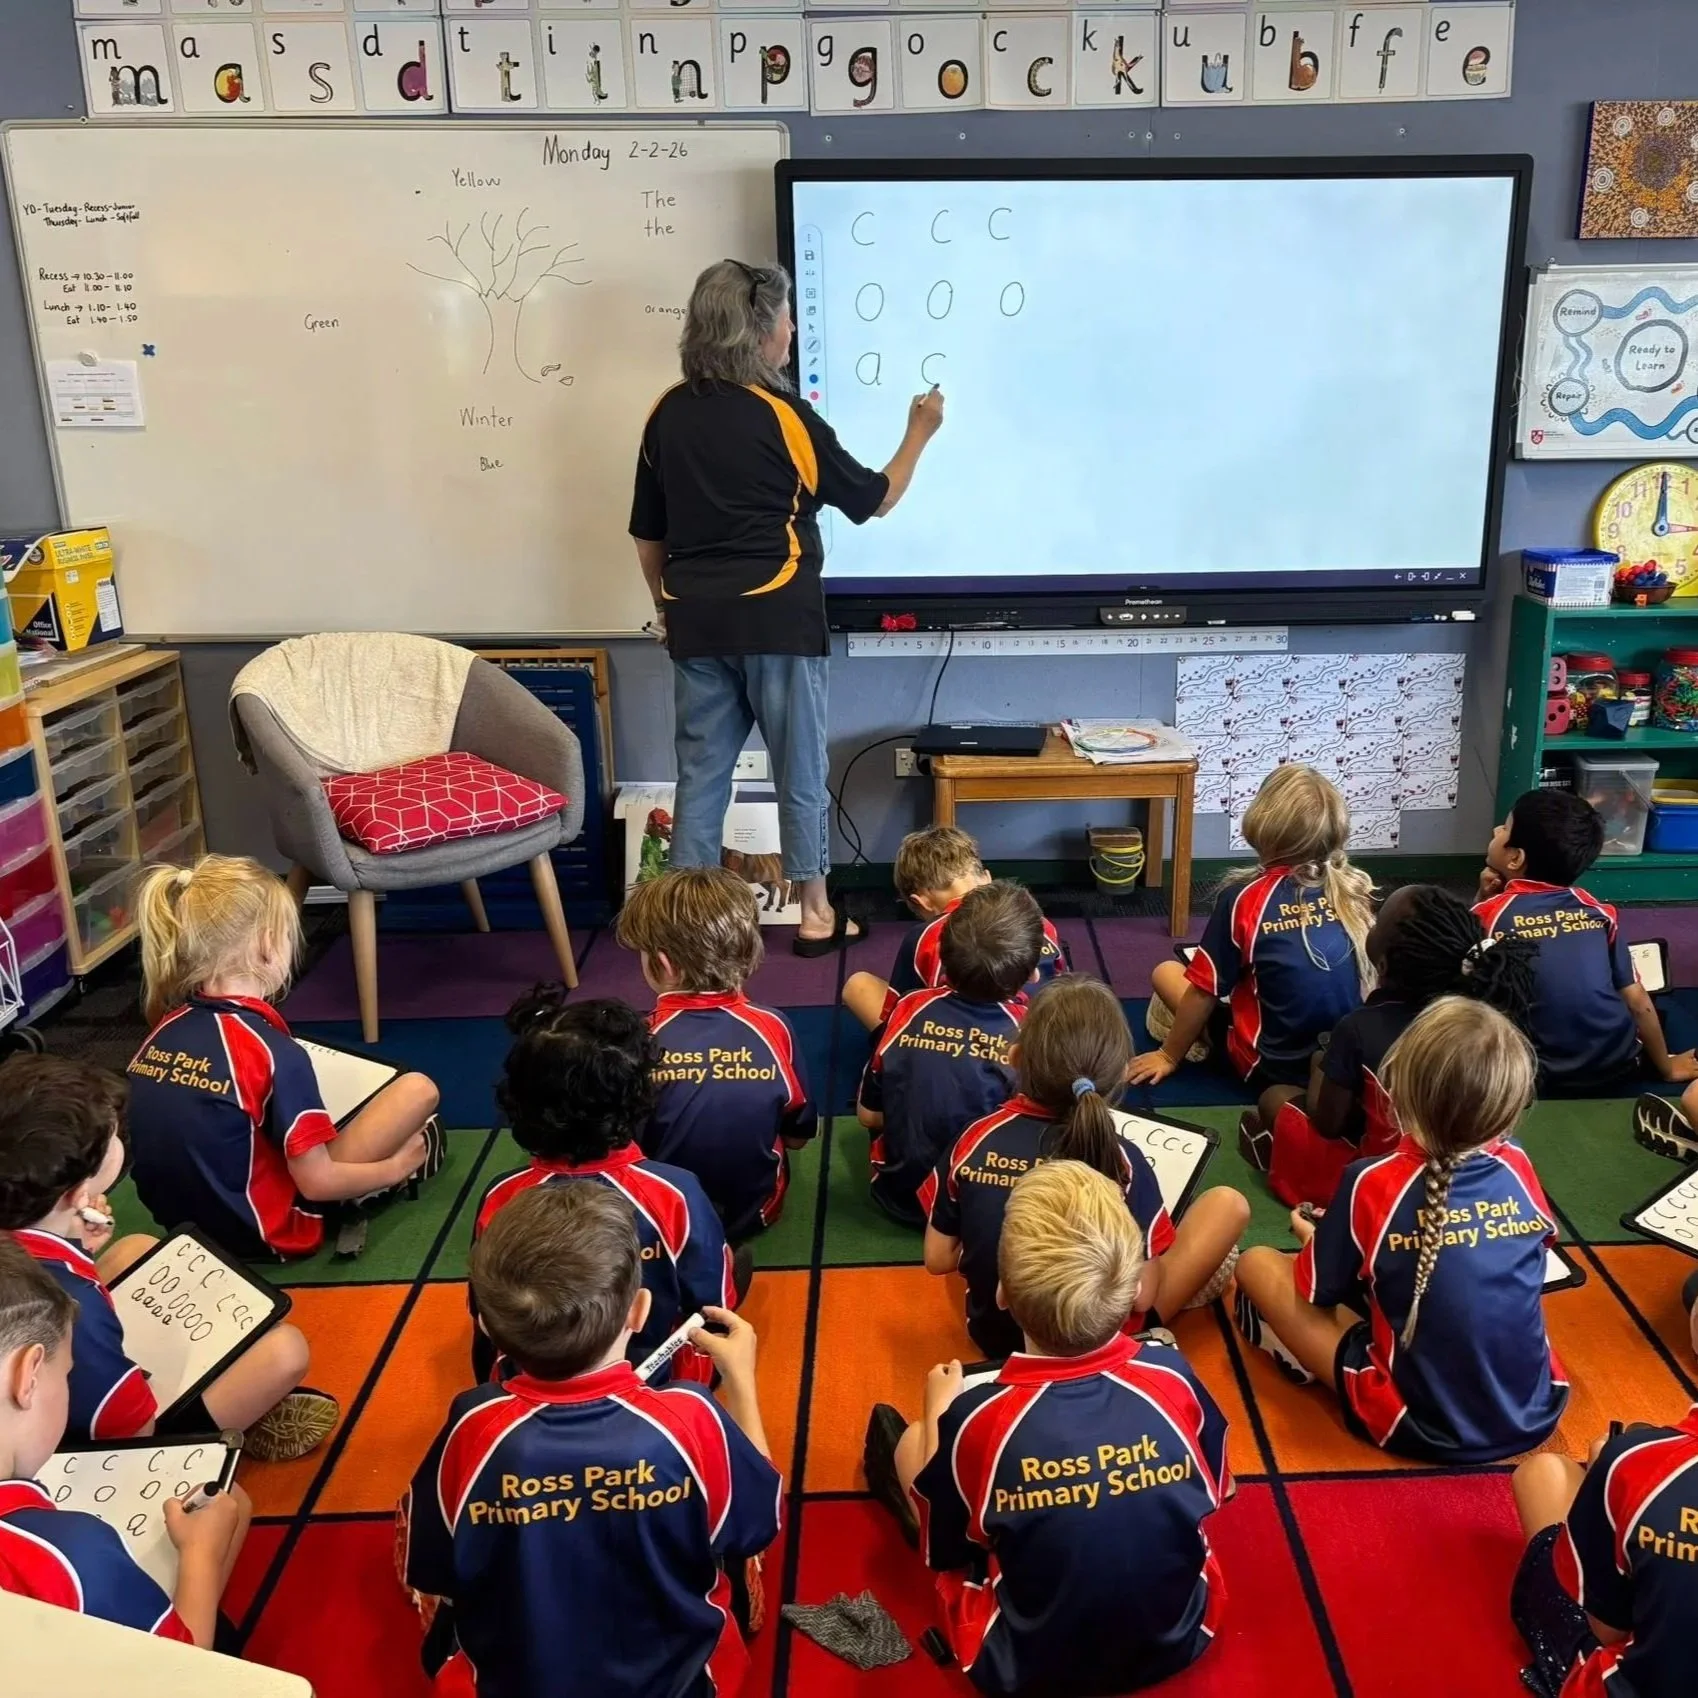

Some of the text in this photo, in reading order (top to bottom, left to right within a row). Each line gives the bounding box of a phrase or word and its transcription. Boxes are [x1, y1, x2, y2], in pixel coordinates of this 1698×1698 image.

[91, 13, 1450, 66] m a s d t i n p g o c k u b f e
[110, 27, 1491, 108] m a s d t i n p g o c k u b f e
[543, 134, 689, 170] Monday 2-2-26
[452, 169, 501, 188] Yellow
[641, 190, 677, 208] The
[643, 218, 675, 235] the
[39, 267, 69, 280] Recess
[63, 284, 76, 293] Eat
[44, 300, 70, 311] Lunch
[1559, 306, 1597, 316] Remind
[66, 315, 80, 325] Eat
[304, 314, 340, 329] Green
[1628, 345, 1675, 357] Ready to
[856, 352, 882, 385] a
[1635, 360, 1665, 370] Learn
[1555, 392, 1582, 400] Repair
[460, 408, 514, 427] Winter
[480, 456, 504, 472] Blue
[1630, 480, 1647, 498] 11
[1614, 501, 1633, 518] 10
[1608, 522, 1619, 539] 9
[1675, 558, 1686, 575] 5
[1124, 598, 1163, 606] Promethean
[916, 640, 923, 649] 5
[982, 640, 991, 650] 10
[1057, 639, 1066, 648] 15
[1127, 638, 1139, 648] 20
[1202, 636, 1215, 645] 25
[1276, 634, 1288, 644] 30
[1279, 902, 1316, 916] Ross
[1513, 908, 1589, 927] Ross Park
[923, 1020, 1009, 1049] Ross Park
[899, 1033, 965, 1057] Primary
[145, 1045, 212, 1072] Ross Park
[709, 1046, 752, 1063] Park
[170, 1067, 230, 1094] School
[712, 1063, 776, 1081] School
[985, 1151, 1029, 1171] Ross
[959, 1166, 1019, 1188] Primar
[1475, 1196, 1521, 1219] Park
[1388, 1215, 1549, 1251] Priary School
[1020, 1434, 1160, 1483] Ross Park
[502, 1459, 657, 1499] Ross Park
[995, 1454, 1192, 1513] Primary School
[468, 1476, 692, 1526] Primary School
[1638, 1525, 1698, 1562] Prim
